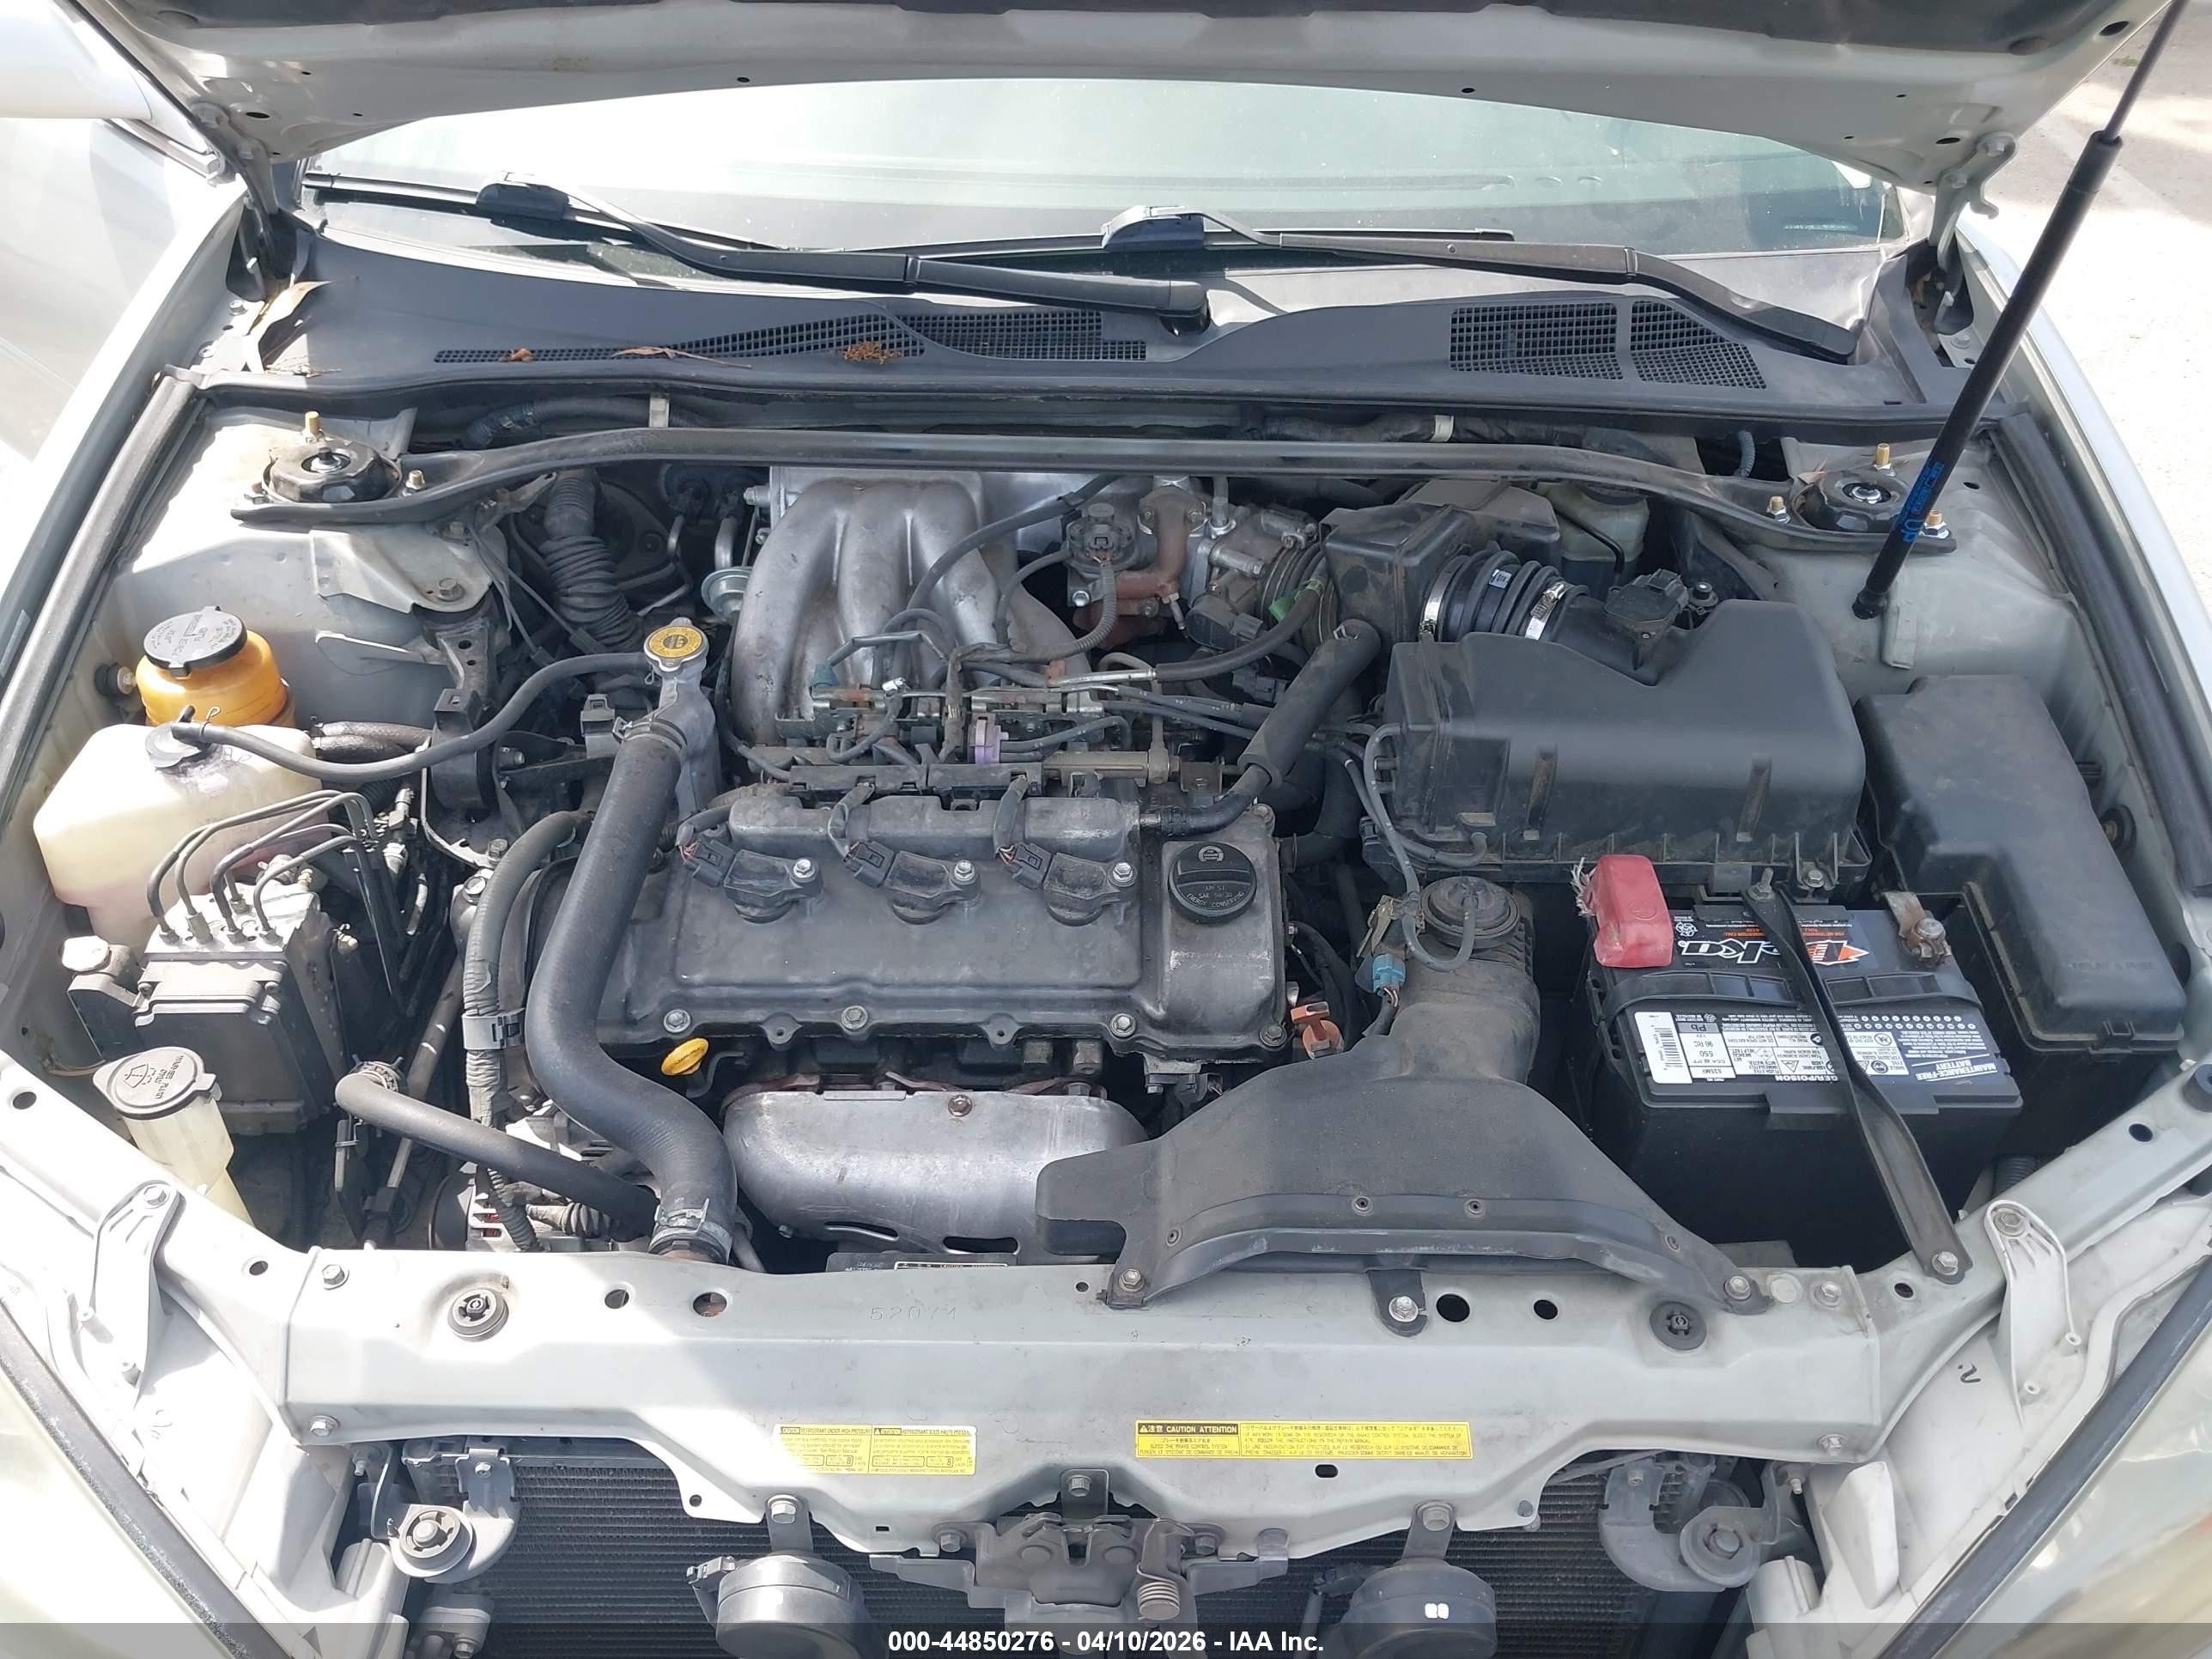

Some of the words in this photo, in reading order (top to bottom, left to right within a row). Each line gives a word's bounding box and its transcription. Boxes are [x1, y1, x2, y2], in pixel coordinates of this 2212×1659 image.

[1185, 892, 1207, 907] ENERGY
[1916, 1063, 1996, 1080] MAINTENANCE-FREE
[1936, 1060, 1972, 1070] BATTERY
